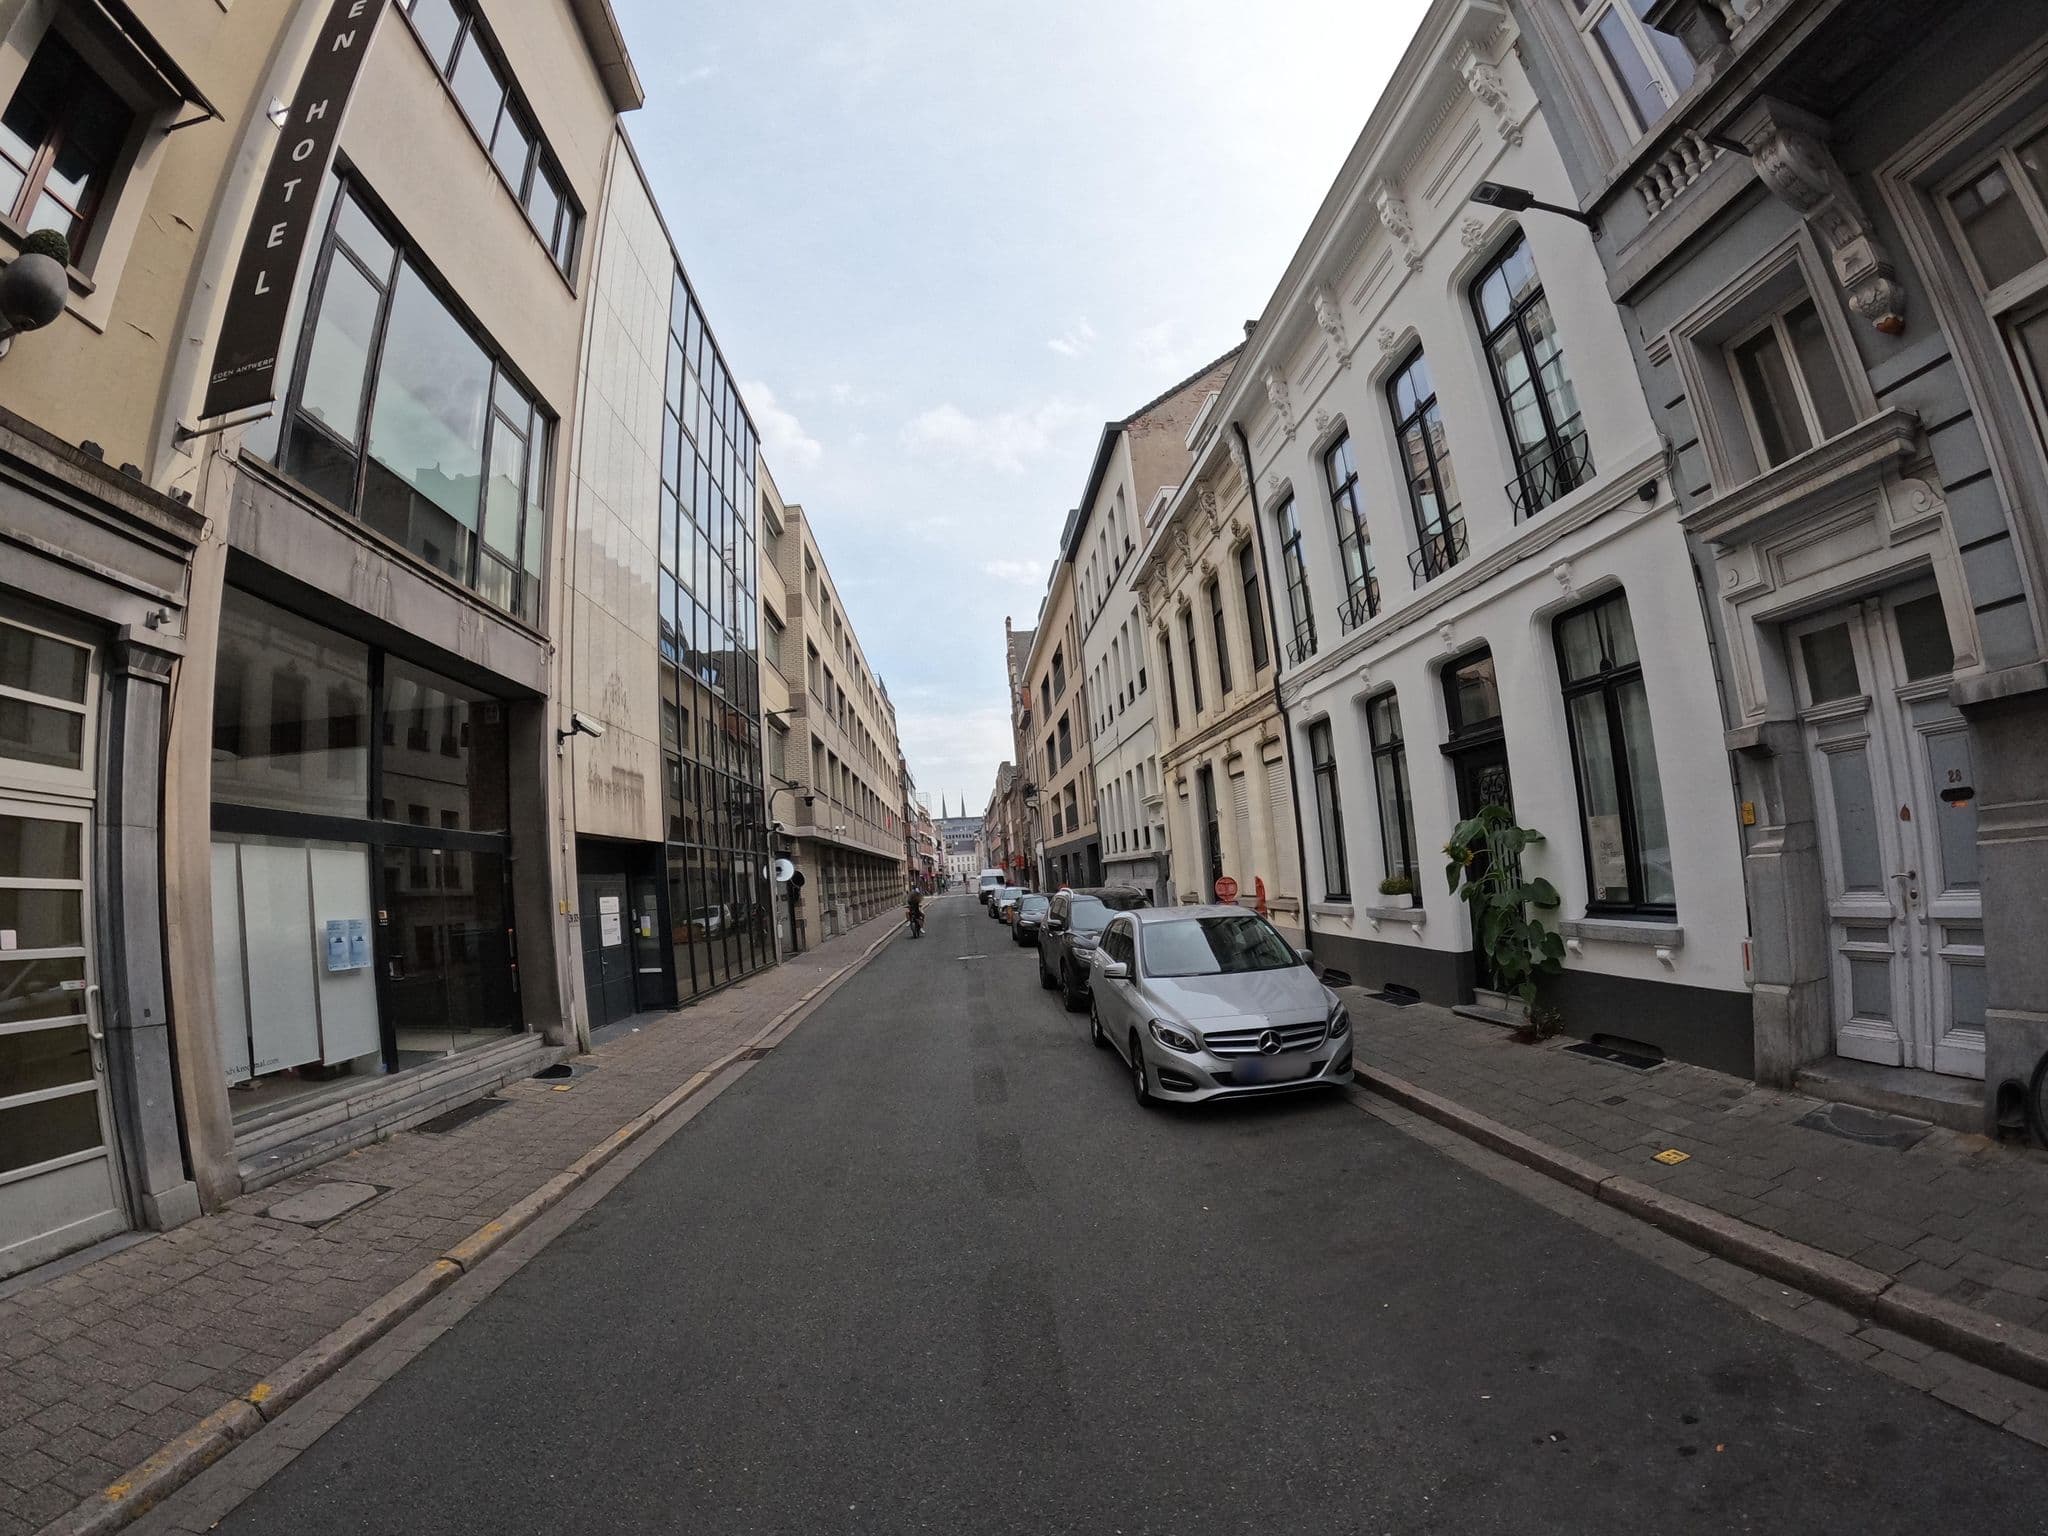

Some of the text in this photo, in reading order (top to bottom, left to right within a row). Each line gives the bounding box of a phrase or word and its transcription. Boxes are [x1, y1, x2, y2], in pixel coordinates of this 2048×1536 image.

[254, 99, 329, 296] HOTEL
[212, 357, 274, 380] EDEN ANTWERP
